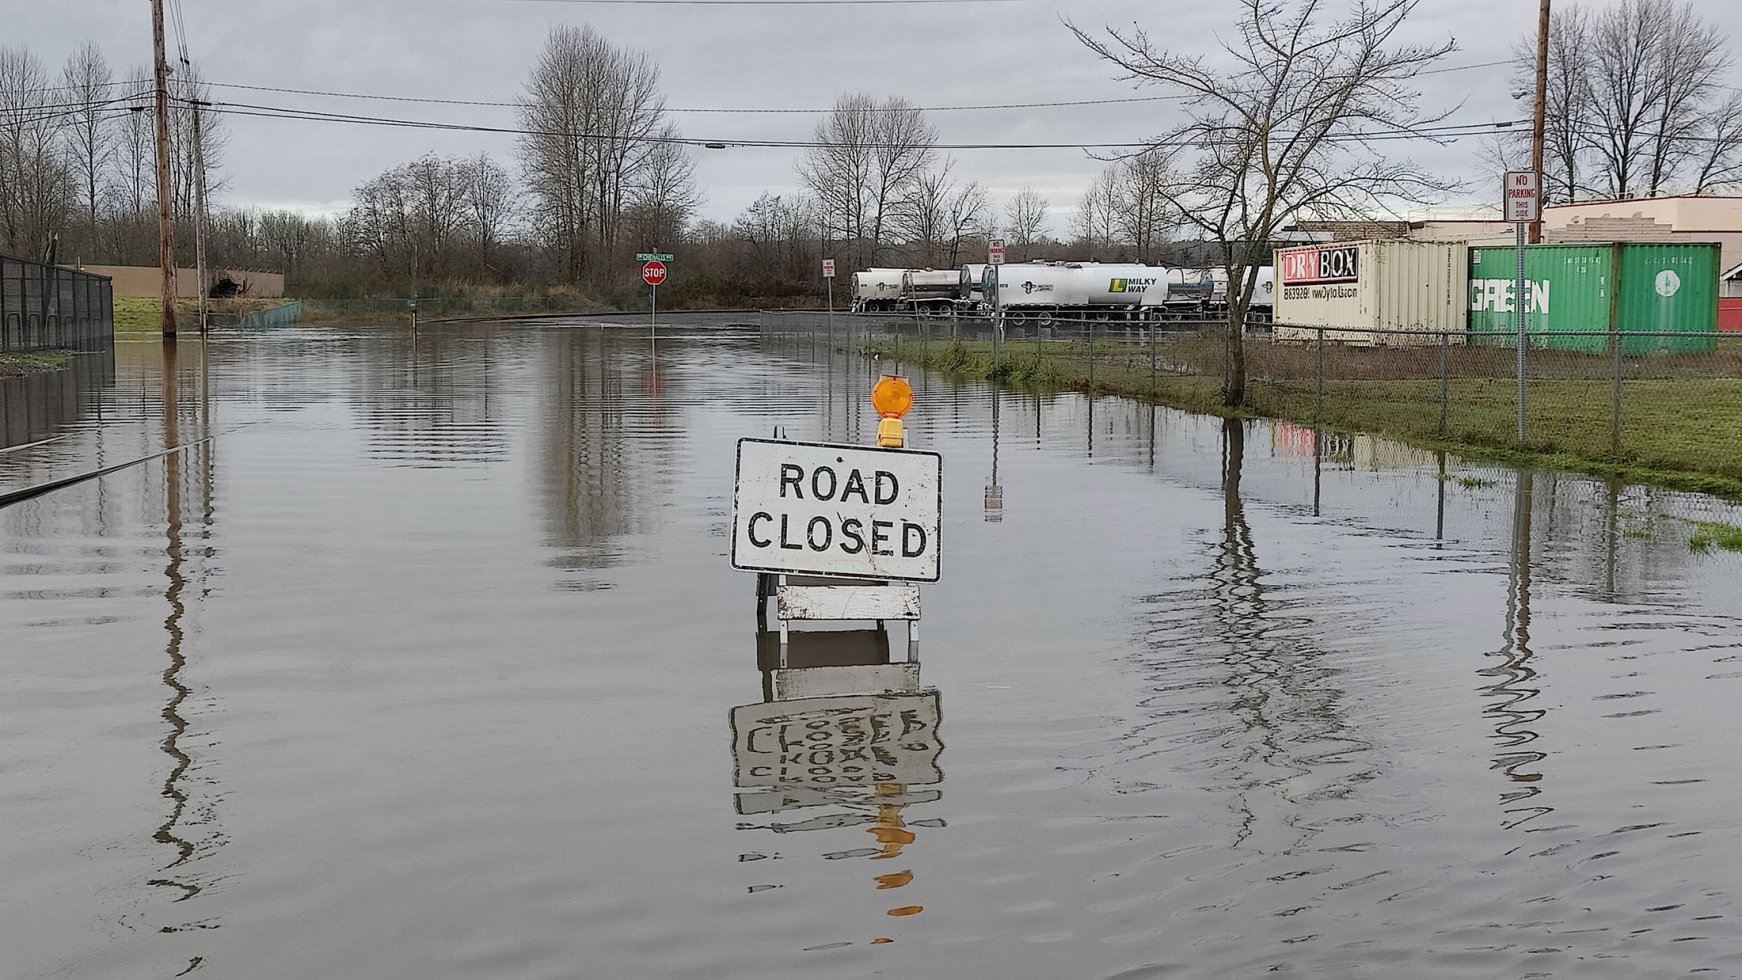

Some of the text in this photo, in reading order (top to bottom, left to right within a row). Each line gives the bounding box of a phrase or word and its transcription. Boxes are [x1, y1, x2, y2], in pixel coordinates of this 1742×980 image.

[1515, 175, 1528, 186] NO
[1508, 188, 1536, 199] PARKING
[644, 268, 665, 278] STOP
[1128, 278, 1157, 286] MILKY
[1127, 285, 1148, 293] WAY
[779, 463, 899, 505] ROAD
[747, 511, 927, 558] CLOSED
